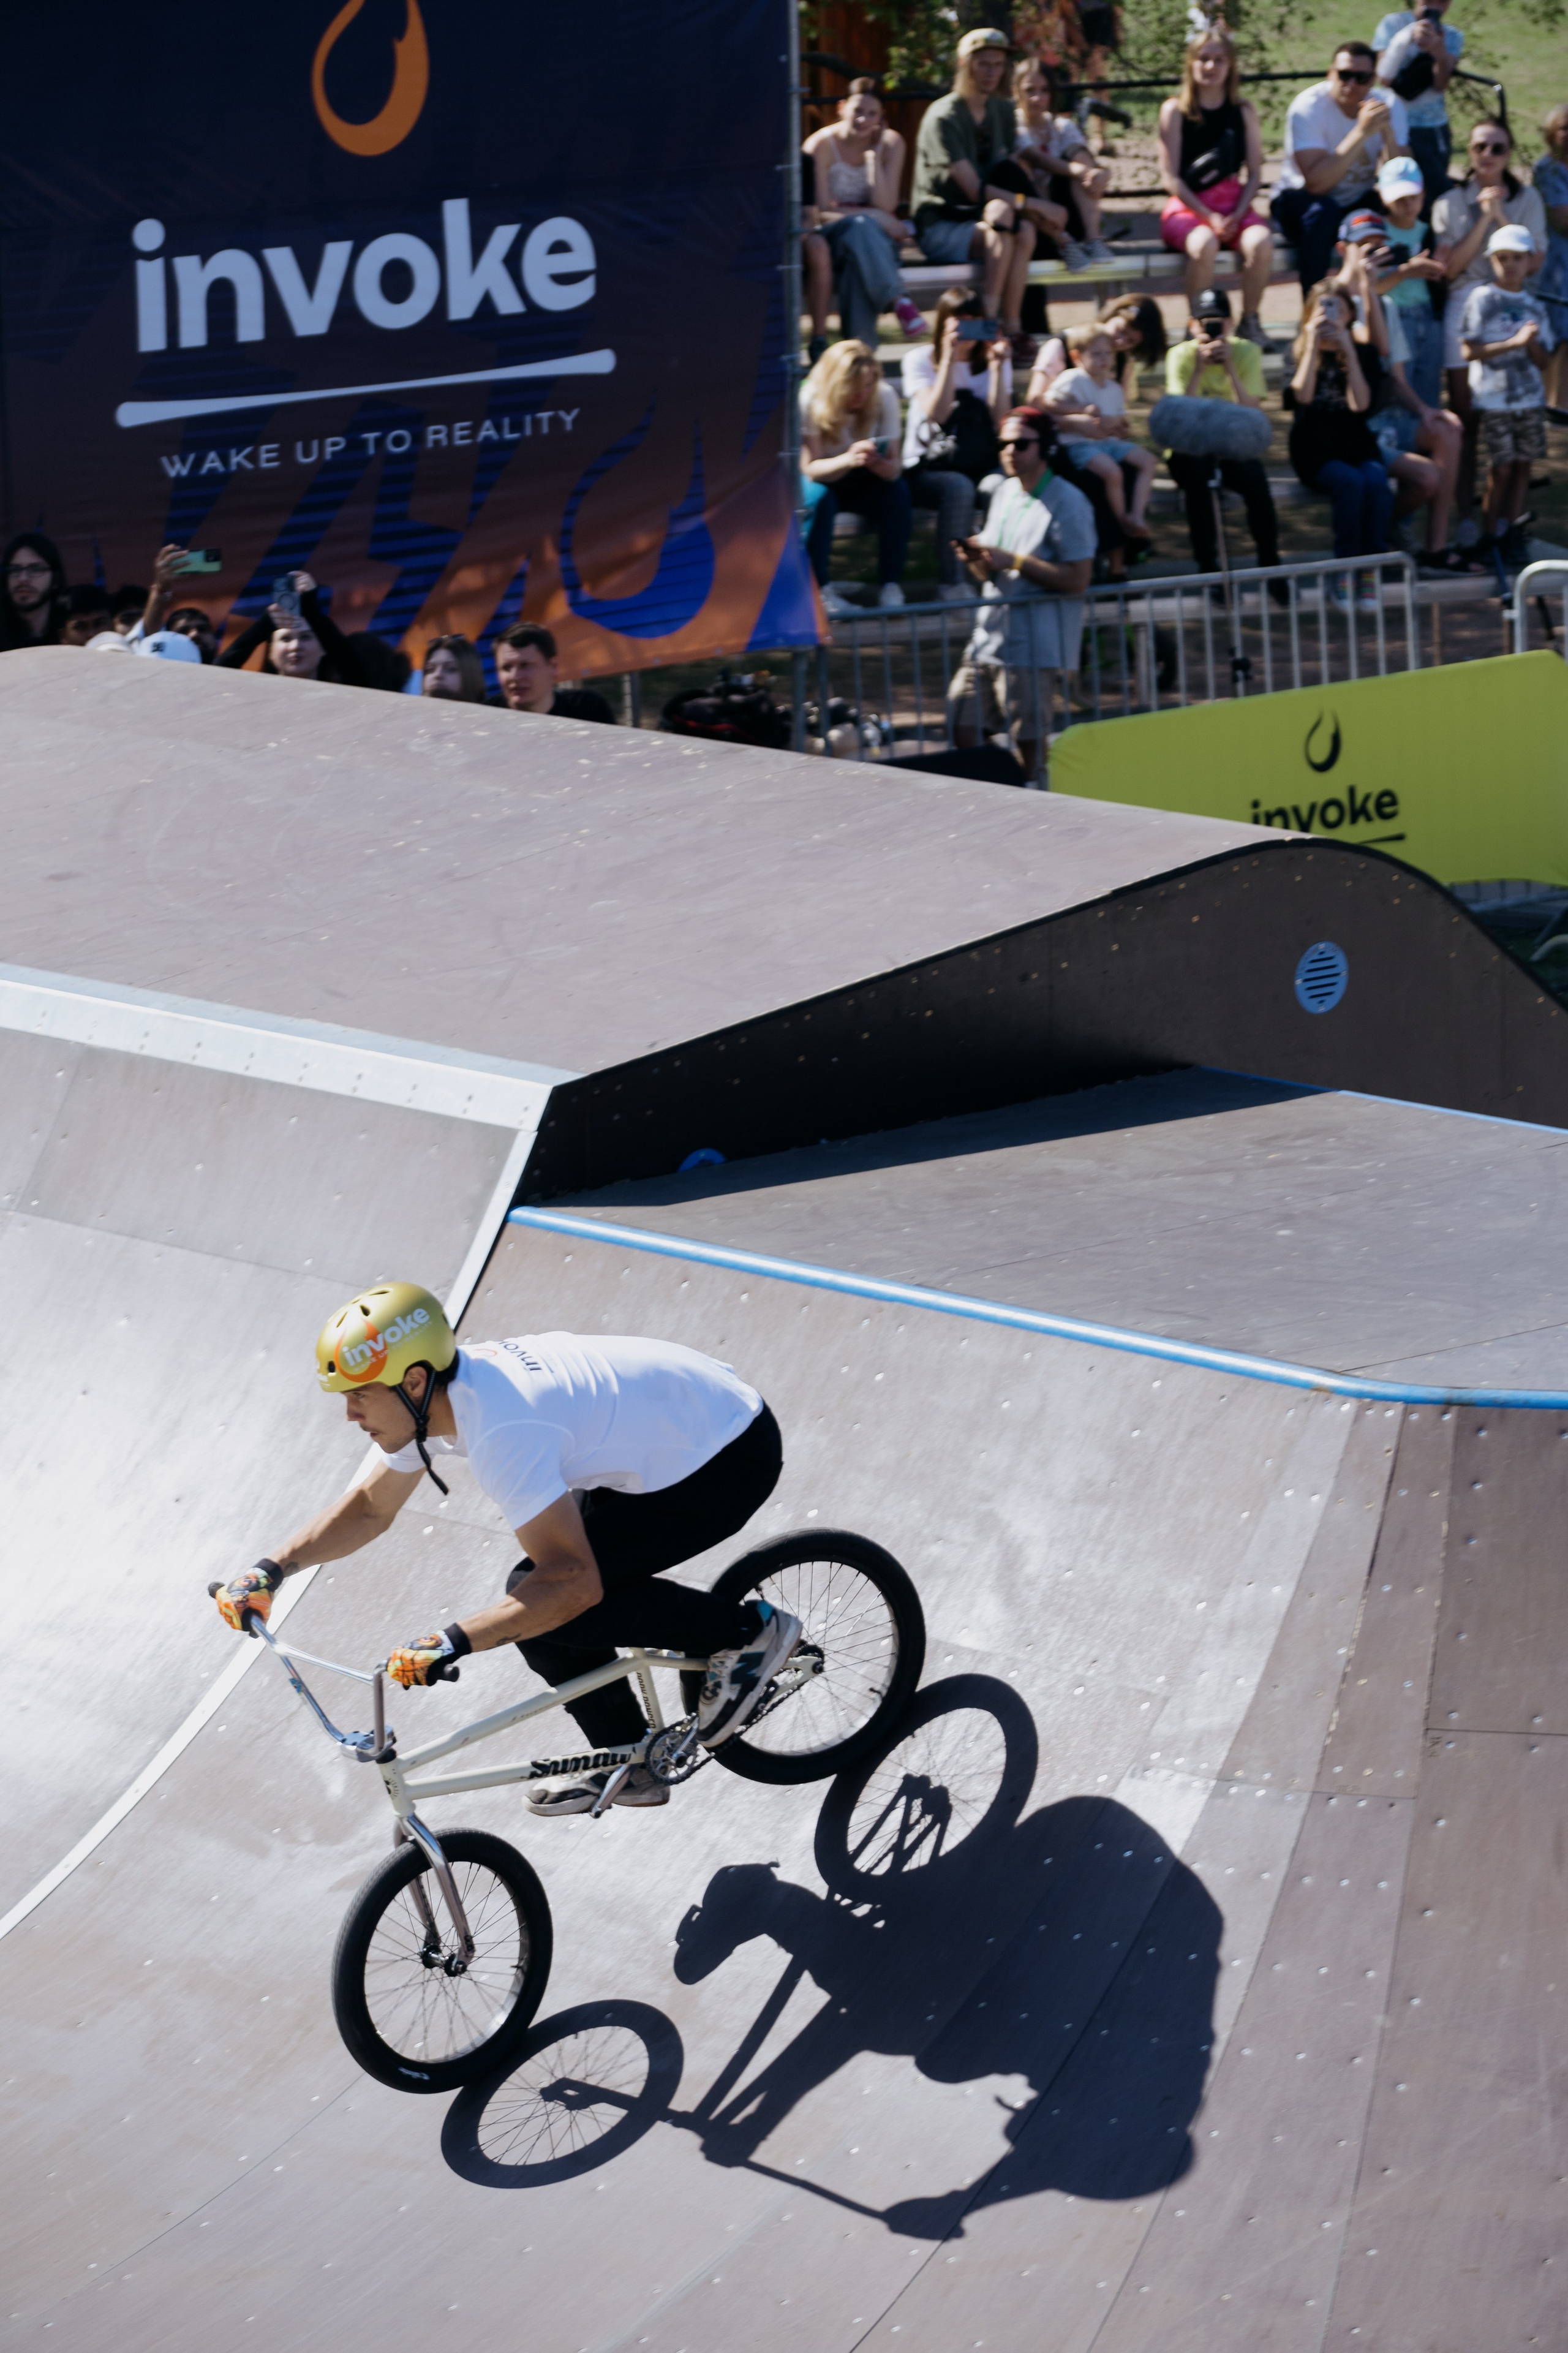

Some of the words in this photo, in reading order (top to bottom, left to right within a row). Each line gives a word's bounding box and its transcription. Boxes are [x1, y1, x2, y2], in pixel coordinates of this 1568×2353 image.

[132, 198, 597, 352] invoke
[160, 443, 281, 478] WAKE
[295, 436, 347, 464] UP
[360, 429, 412, 455] TO
[426, 407, 581, 448] REALITY
[342, 1309, 430, 1367] invoke
